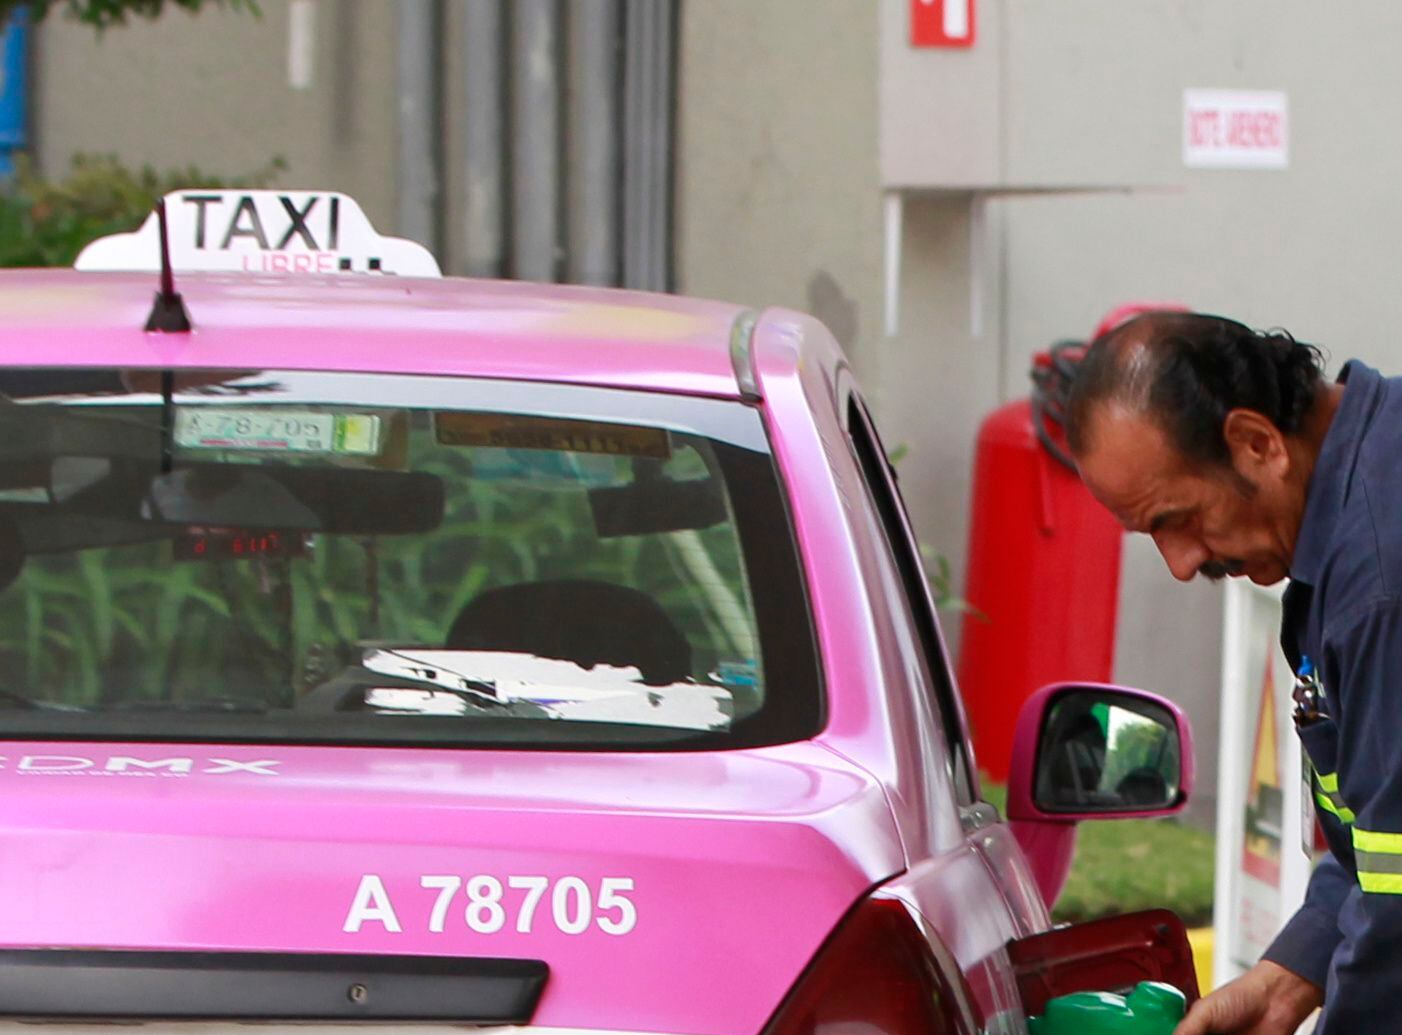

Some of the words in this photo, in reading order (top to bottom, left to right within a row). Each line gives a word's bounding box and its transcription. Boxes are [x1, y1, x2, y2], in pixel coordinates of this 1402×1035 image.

[182, 195, 339, 251] TAXI
[342, 874, 402, 933] A
[420, 874, 637, 935] 78705
